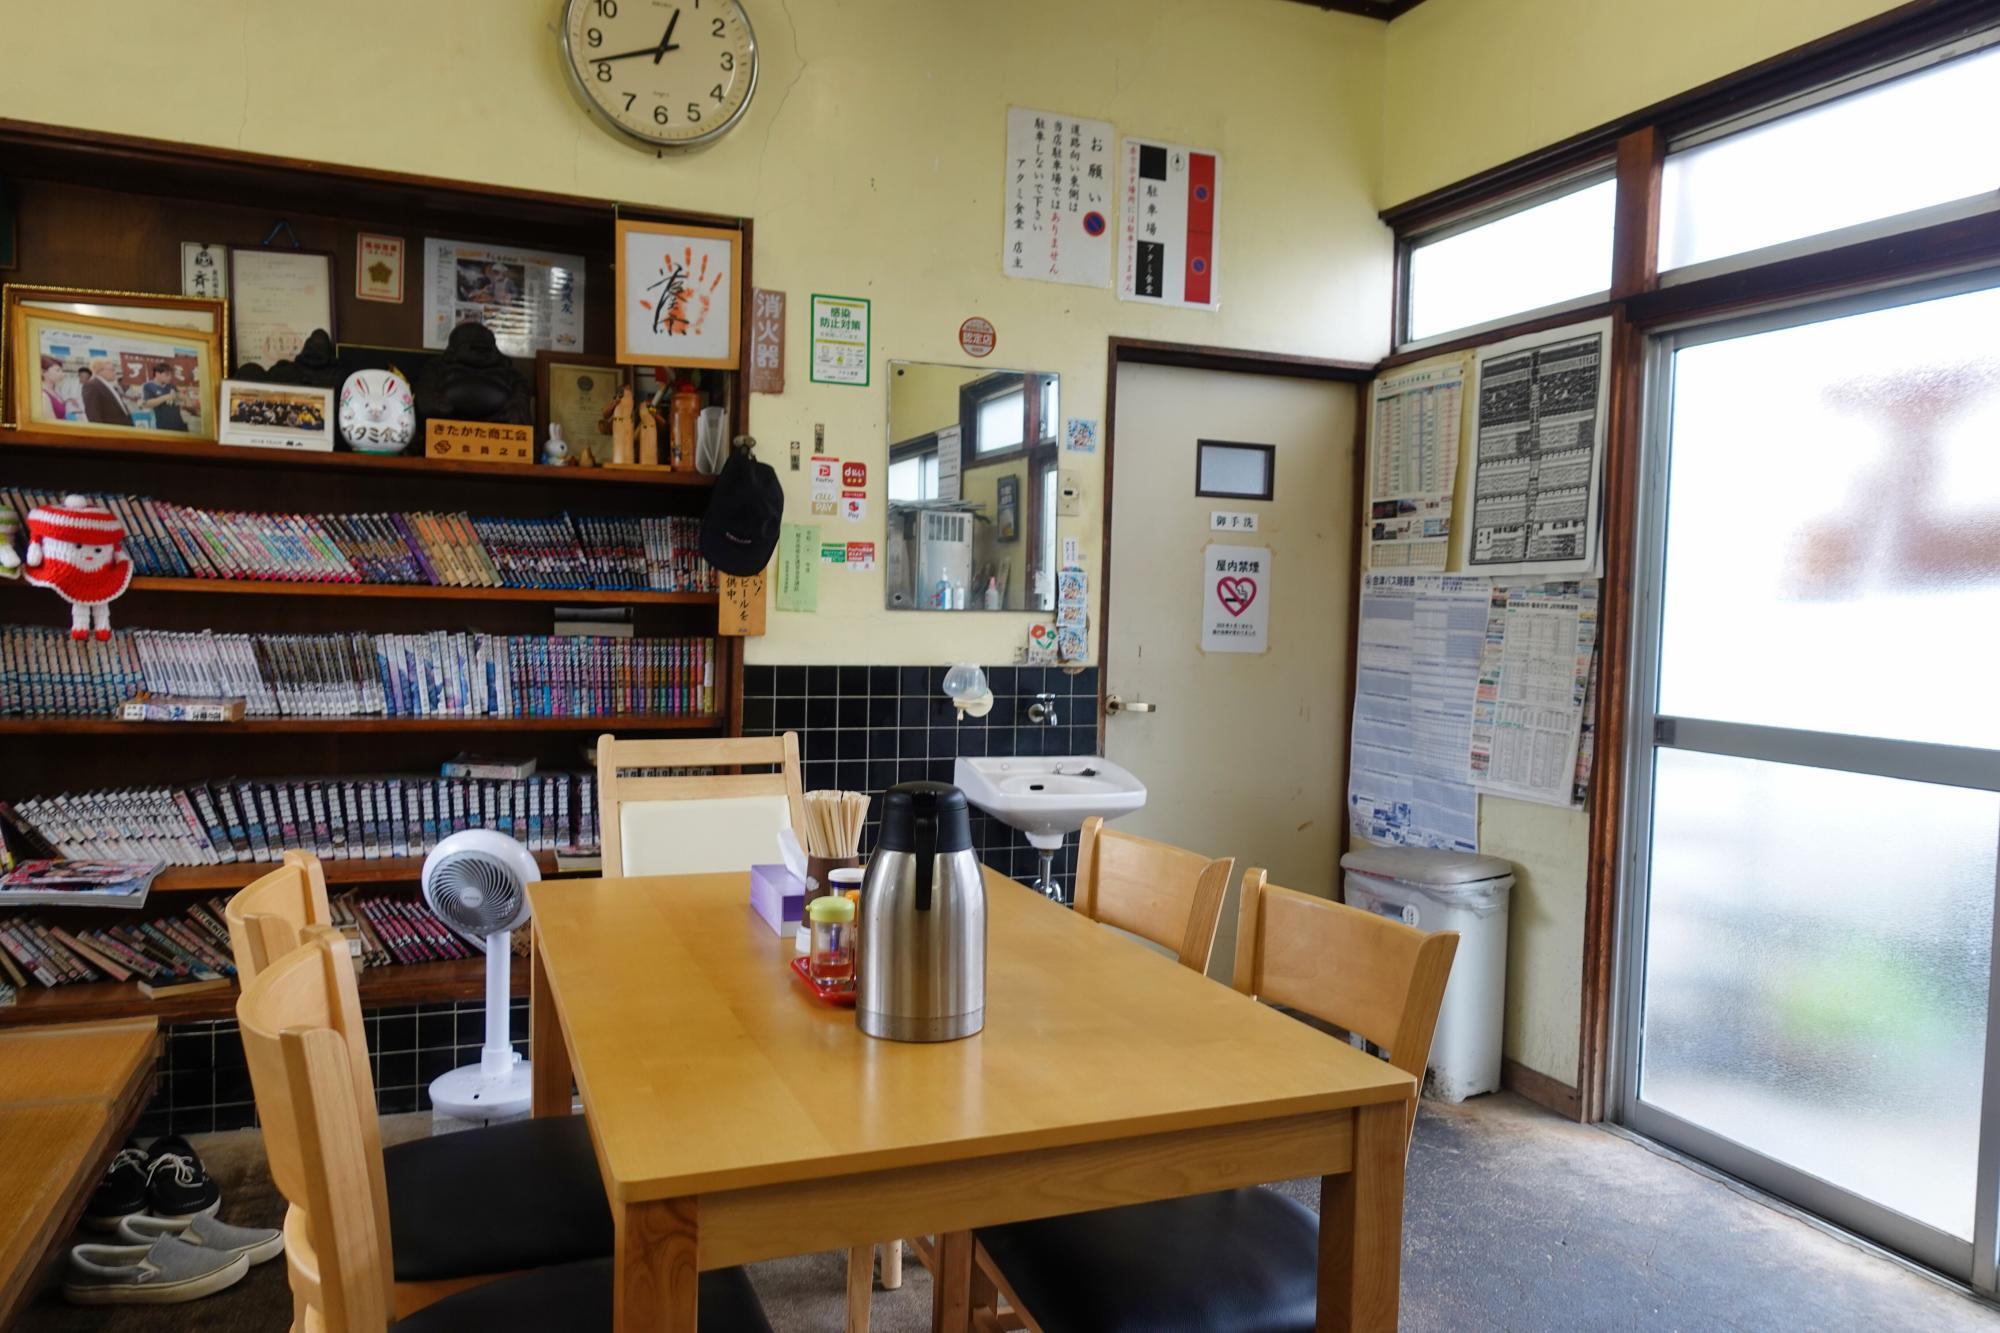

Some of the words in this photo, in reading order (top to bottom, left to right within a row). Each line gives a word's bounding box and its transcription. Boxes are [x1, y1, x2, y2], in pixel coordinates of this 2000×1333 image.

[595, 0, 618, 18] 10
[587, 28, 602, 47] 9
[712, 18, 726, 38] 2
[720, 52, 734, 71] 3
[597, 63, 612, 82] 8
[622, 92, 636, 111] 7
[710, 84, 724, 103] 4
[654, 105, 668, 124] 6
[687, 103, 701, 122] 5
[1032, 117, 1046, 232] 駐車しないで下さい
[1069, 124, 1081, 213] 道路向い東側は
[1088, 137, 1103, 203] お願い
[1014, 158, 1026, 231] アタミ食堂
[1049, 120, 1063, 275] 当店駐車場ではありません
[1146, 184, 1158, 236] 駐車場
[1012, 241, 1023, 269] 店主
[1144, 244, 1155, 294] アタミ食堂
[830, 307, 851, 318] 感染
[757, 294, 781, 369] 消火器
[819, 317, 861, 331] 防止対策
[1216, 515, 1254, 528] 御手洗
[1215, 559, 1260, 574] 屋内禁煙
[739, 577, 750, 621] ビールを
